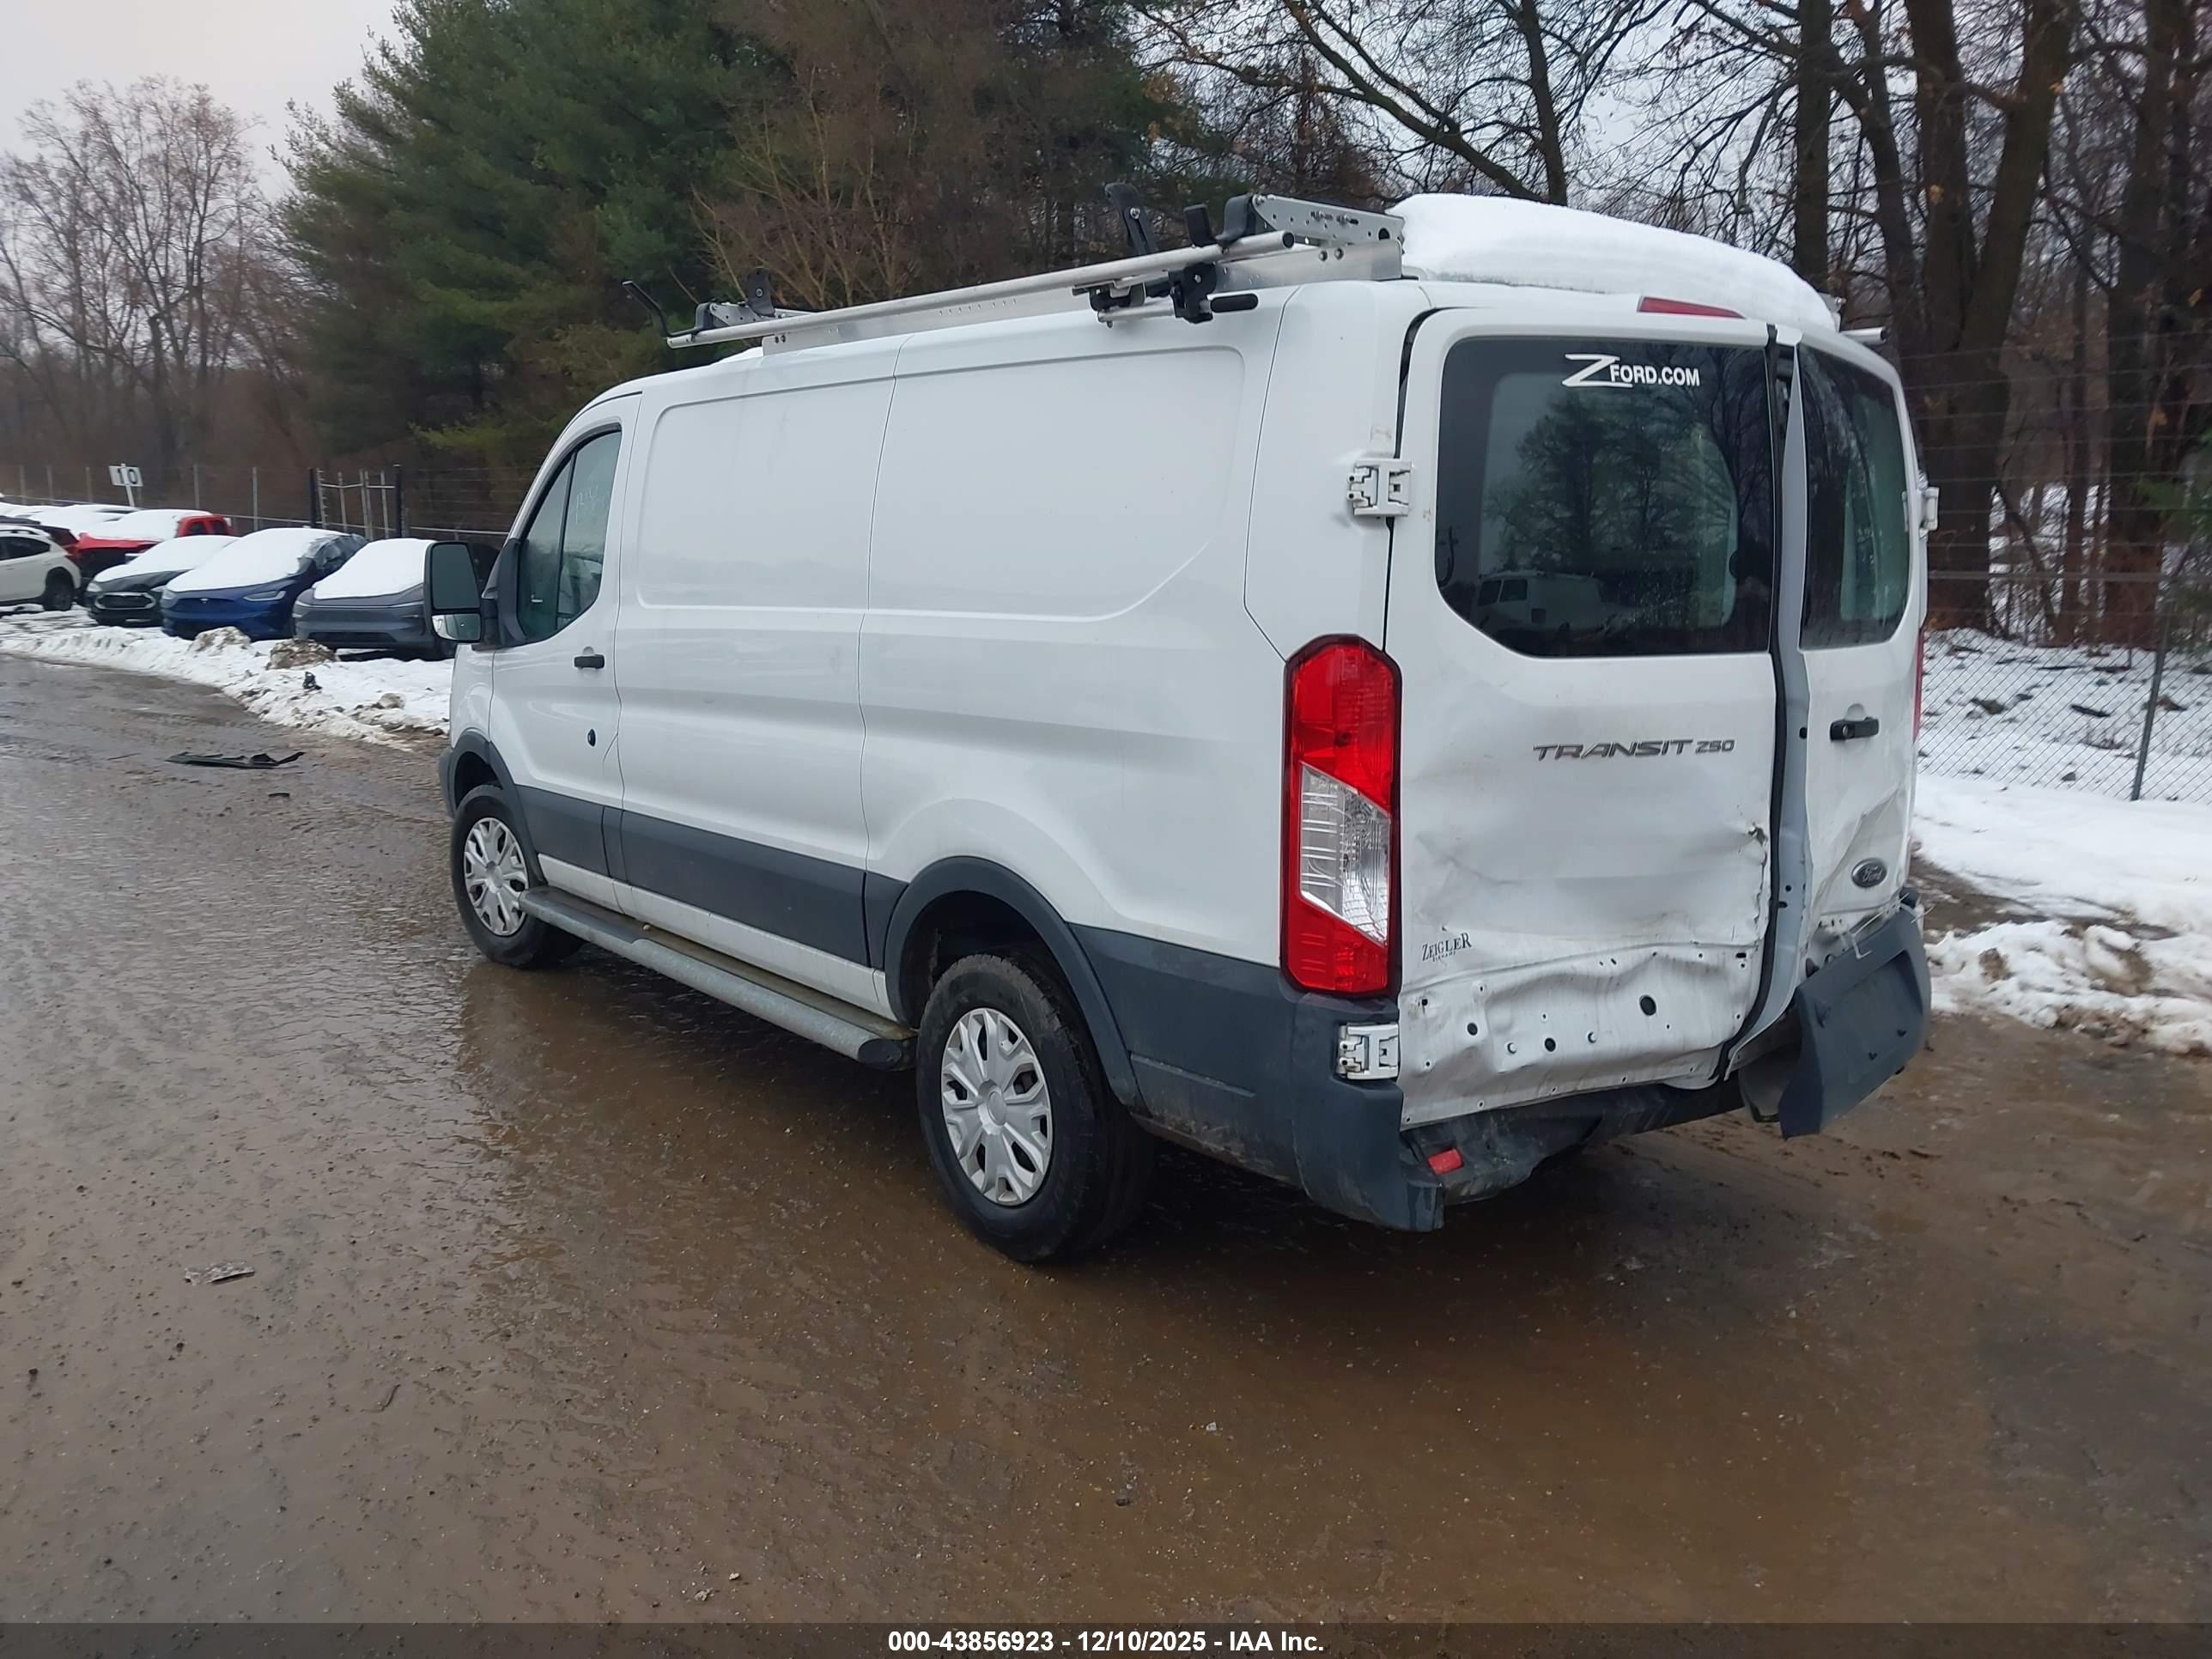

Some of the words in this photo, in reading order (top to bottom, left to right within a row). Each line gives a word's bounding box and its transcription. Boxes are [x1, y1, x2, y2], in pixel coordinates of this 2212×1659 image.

[117, 468, 138, 484] 10
[1533, 739, 1693, 762] TRANSIT
[1695, 739, 1735, 755] 250
[1422, 932, 1473, 962] ZEIGLER
